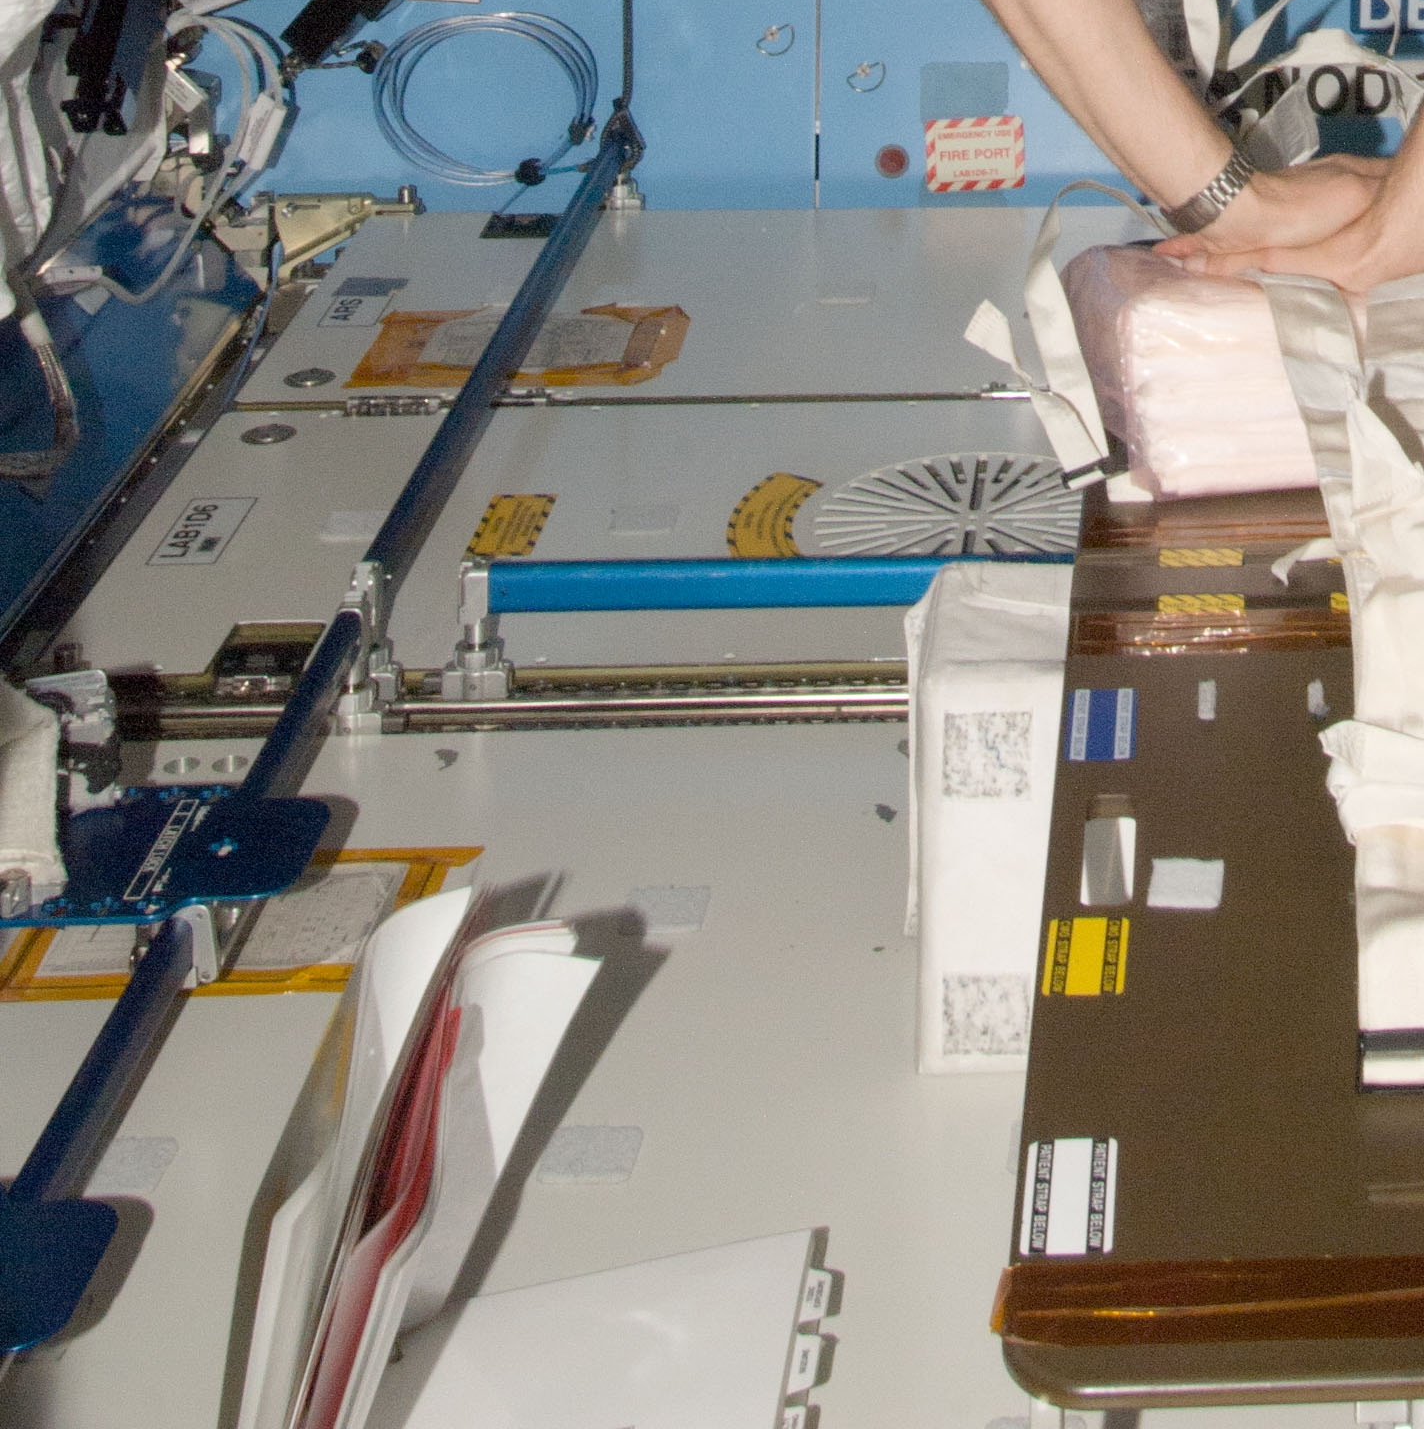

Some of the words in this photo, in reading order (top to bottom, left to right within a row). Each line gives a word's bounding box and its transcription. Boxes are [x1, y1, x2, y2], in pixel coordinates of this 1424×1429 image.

[937, 130, 993, 140] EMERGENCY
[994, 129, 1012, 138] USE
[939, 149, 970, 161] FIRE
[974, 147, 1011, 160] PORT
[329, 296, 364, 322] ARS
[1037, 1144, 1052, 1181] PATIENT
[1093, 1142, 1107, 1179] PATIENT
[1034, 1182, 1049, 1214] STRAP
[1091, 1181, 1105, 1211] STRAP
[1031, 1214, 1047, 1250] BELOW
[1088, 1213, 1103, 1249] BELOW
